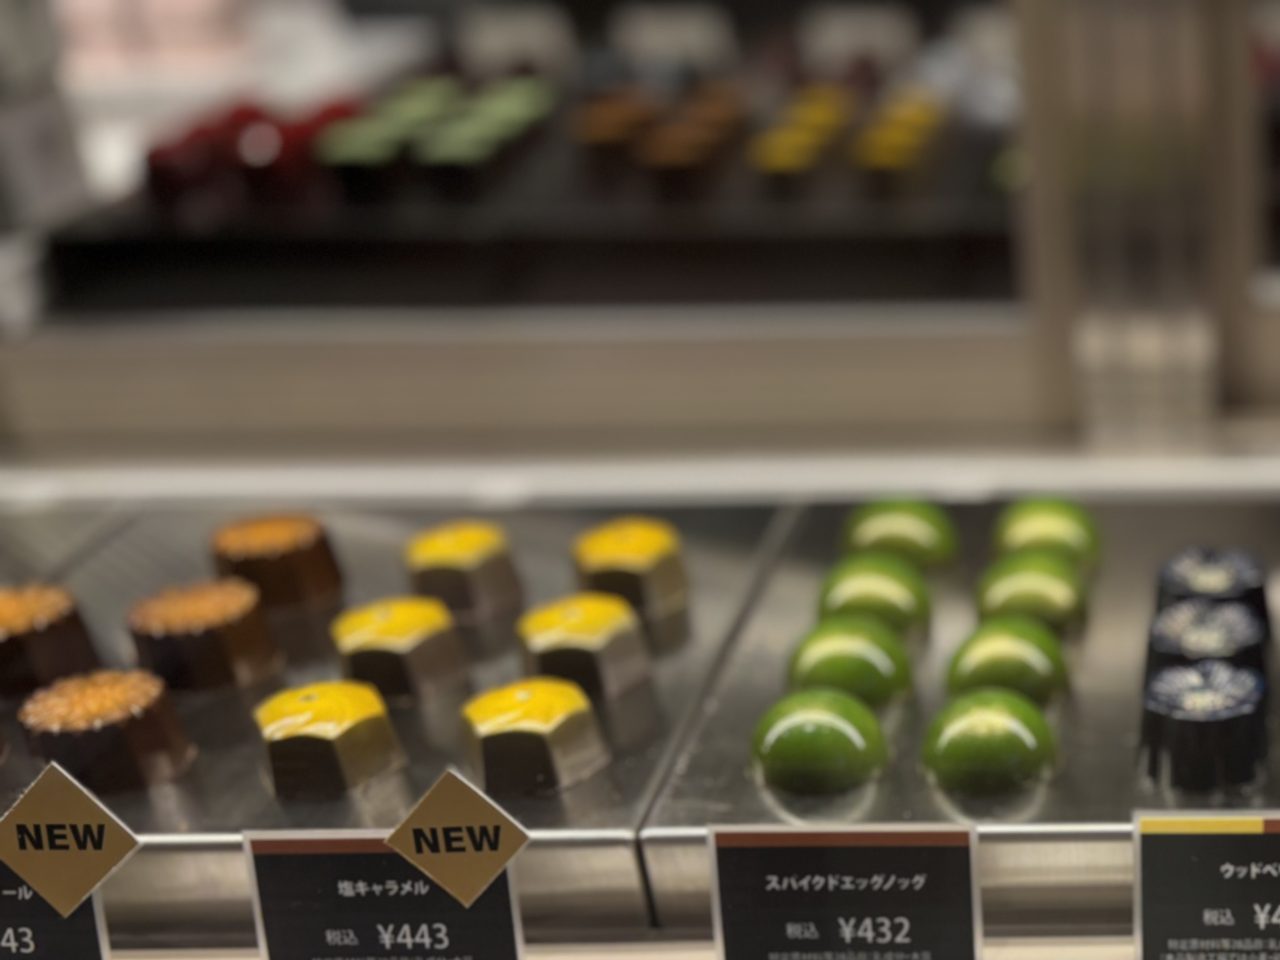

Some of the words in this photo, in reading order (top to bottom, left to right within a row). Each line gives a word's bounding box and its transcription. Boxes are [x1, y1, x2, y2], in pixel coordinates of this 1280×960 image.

[16, 824, 105, 850] NEW
[412, 825, 500, 854] NEW
[337, 878, 431, 897] 塩キャラメル
[766, 874, 926, 891] スパイクドエッグノッグ
[1203, 909, 1234, 925] 税込
[325, 929, 358, 945] 税込
[377, 923, 449, 949] ¥443
[786, 922, 819, 939] 税込
[838, 917, 911, 944] ¥432
